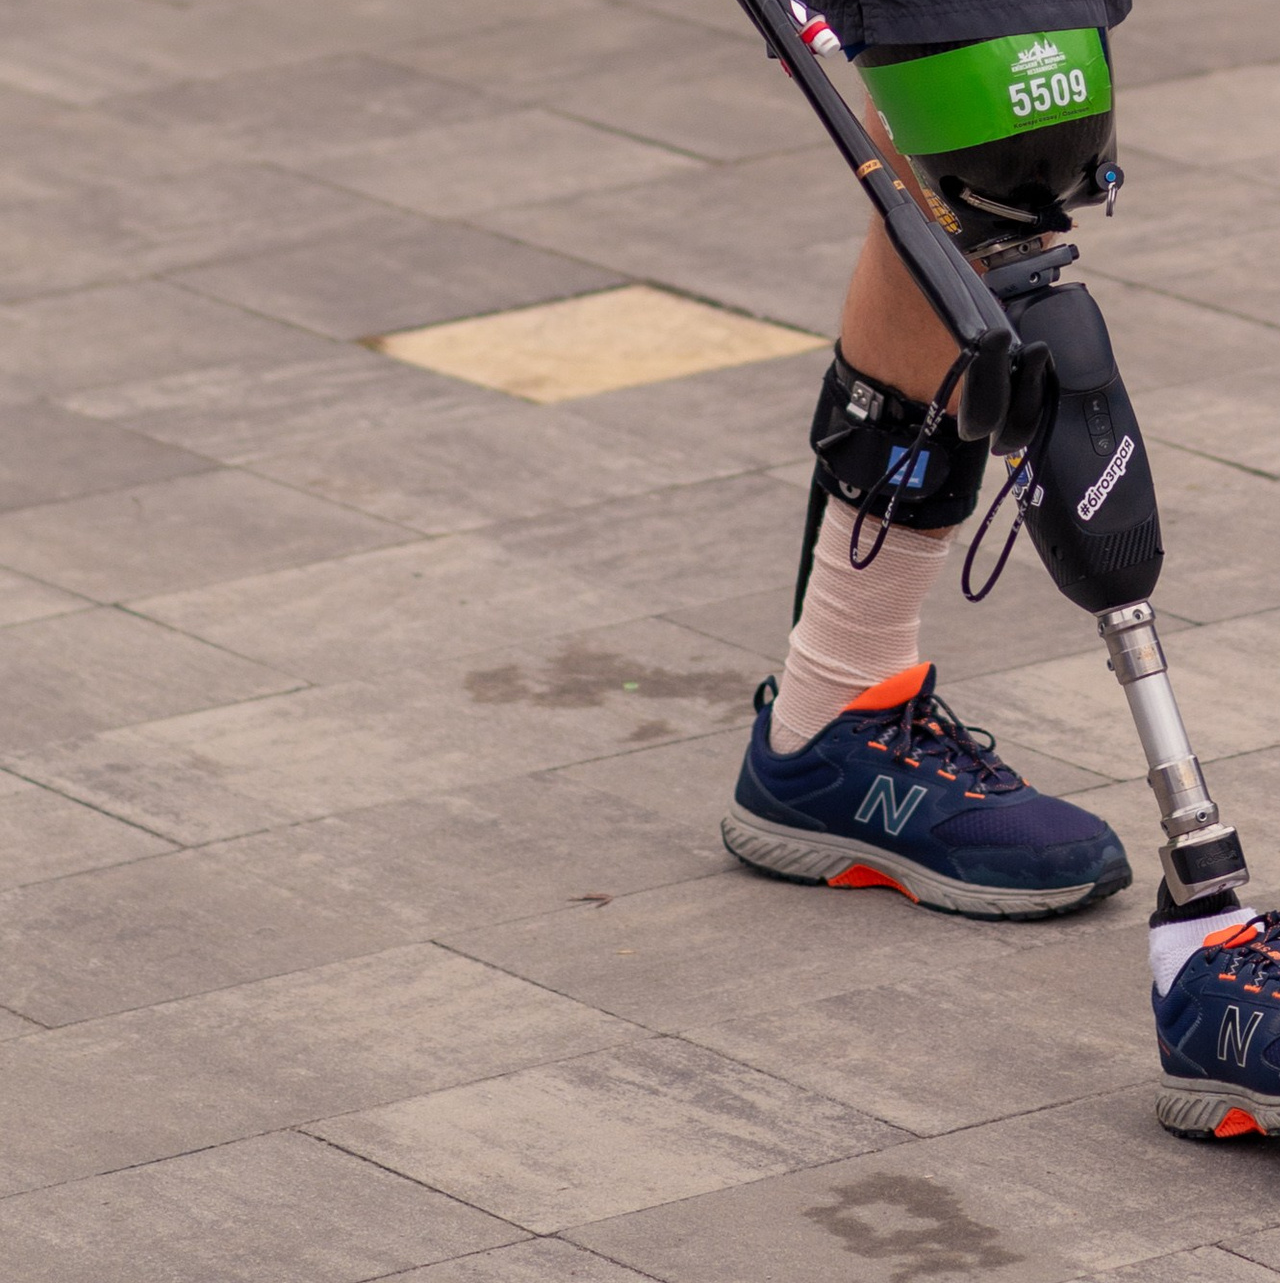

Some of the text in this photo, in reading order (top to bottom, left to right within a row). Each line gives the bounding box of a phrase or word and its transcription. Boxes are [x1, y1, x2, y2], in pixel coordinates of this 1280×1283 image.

[1008, 68, 1088, 117] 5509
[854, 774, 929, 836] N
[1217, 1004, 1264, 1068] N
